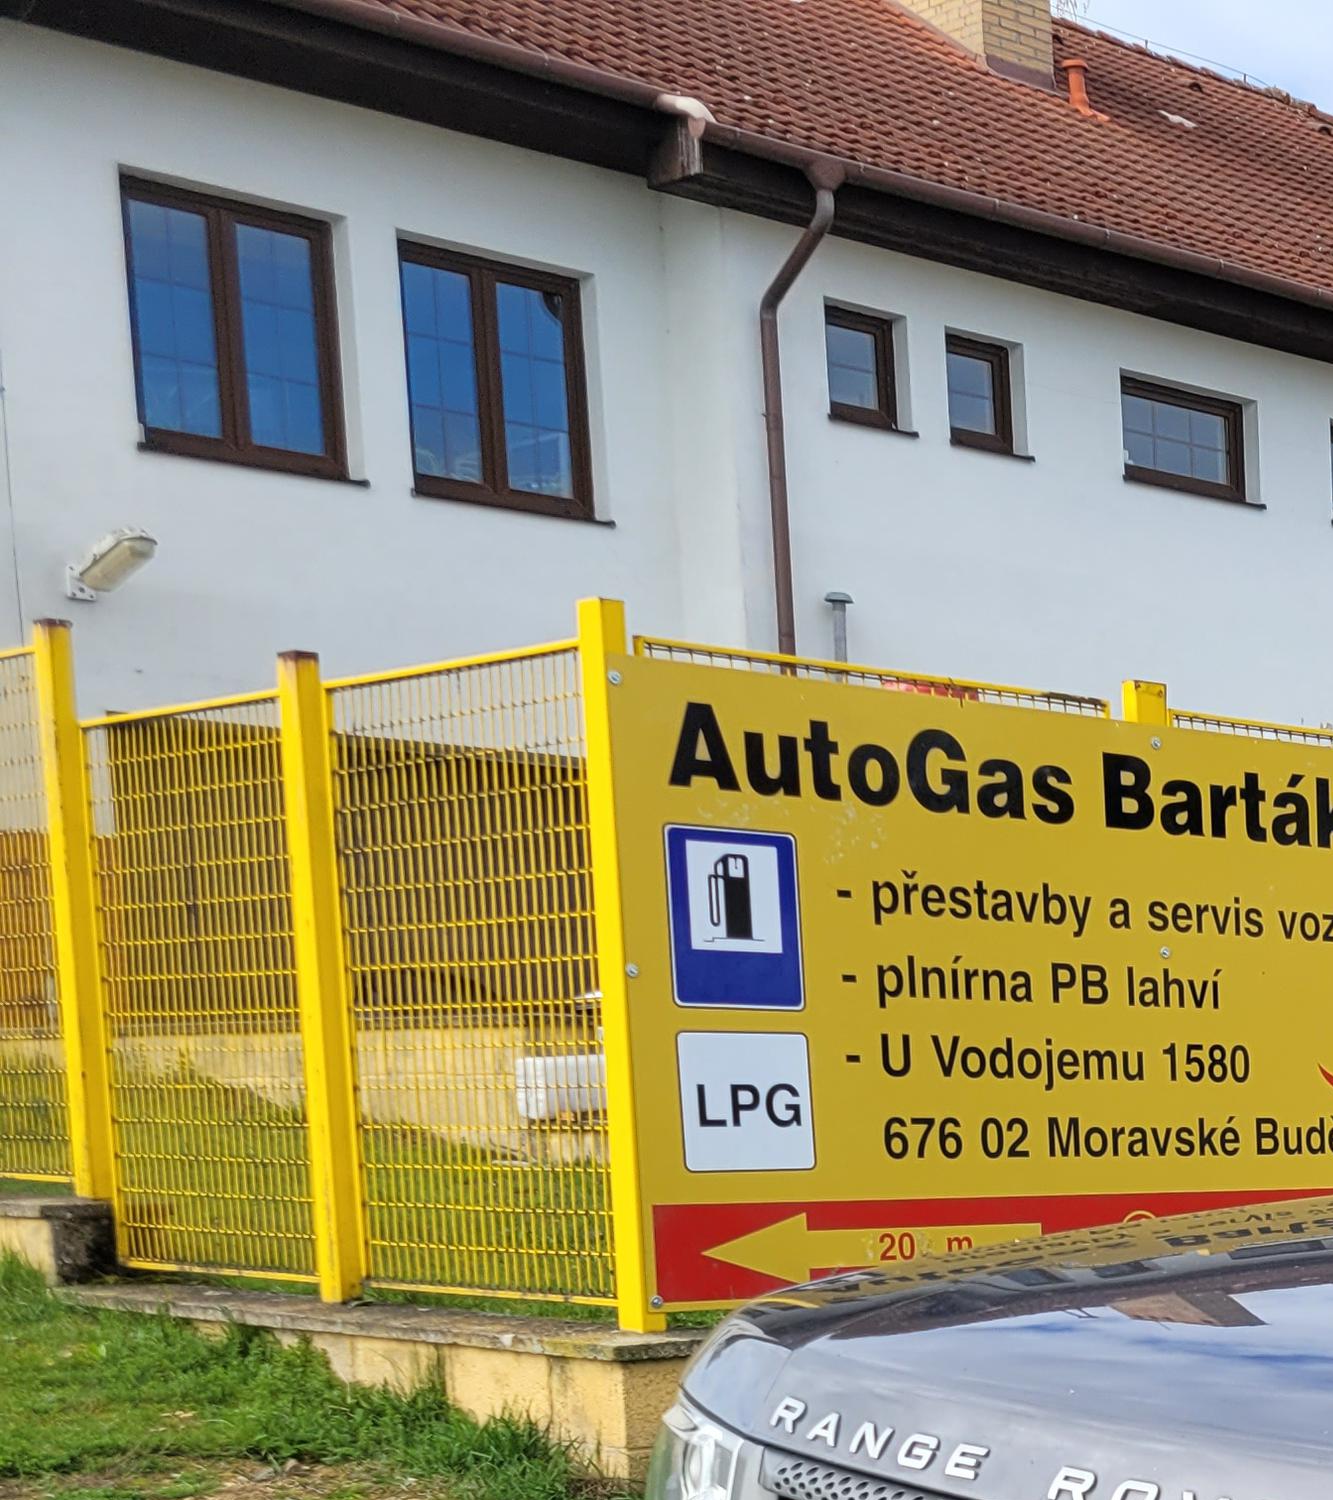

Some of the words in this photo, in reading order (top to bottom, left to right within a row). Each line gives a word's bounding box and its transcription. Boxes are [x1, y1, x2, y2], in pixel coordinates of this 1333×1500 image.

[668, 702, 1075, 824] AutoGas
[872, 870, 1092, 938] přestavby
[1109, 898, 1131, 930] a
[1148, 897, 1264, 938] servis
[877, 955, 1033, 1008] plnírna
[1051, 962, 1109, 1006] PB
[1127, 966, 1222, 1010] lahví
[881, 1034, 911, 1077] U
[931, 1034, 1144, 1091] Vodojemu
[1162, 1042, 1250, 1083] 1580
[696, 1083, 802, 1127] LPG
[884, 1116, 963, 1159] 676
[981, 1116, 1030, 1158] 02
[1048, 1115, 1240, 1158] Moravské
[878, 1231, 916, 1261] 20
[947, 1235, 973, 1255] m
[770, 1395, 991, 1481] RANGE
